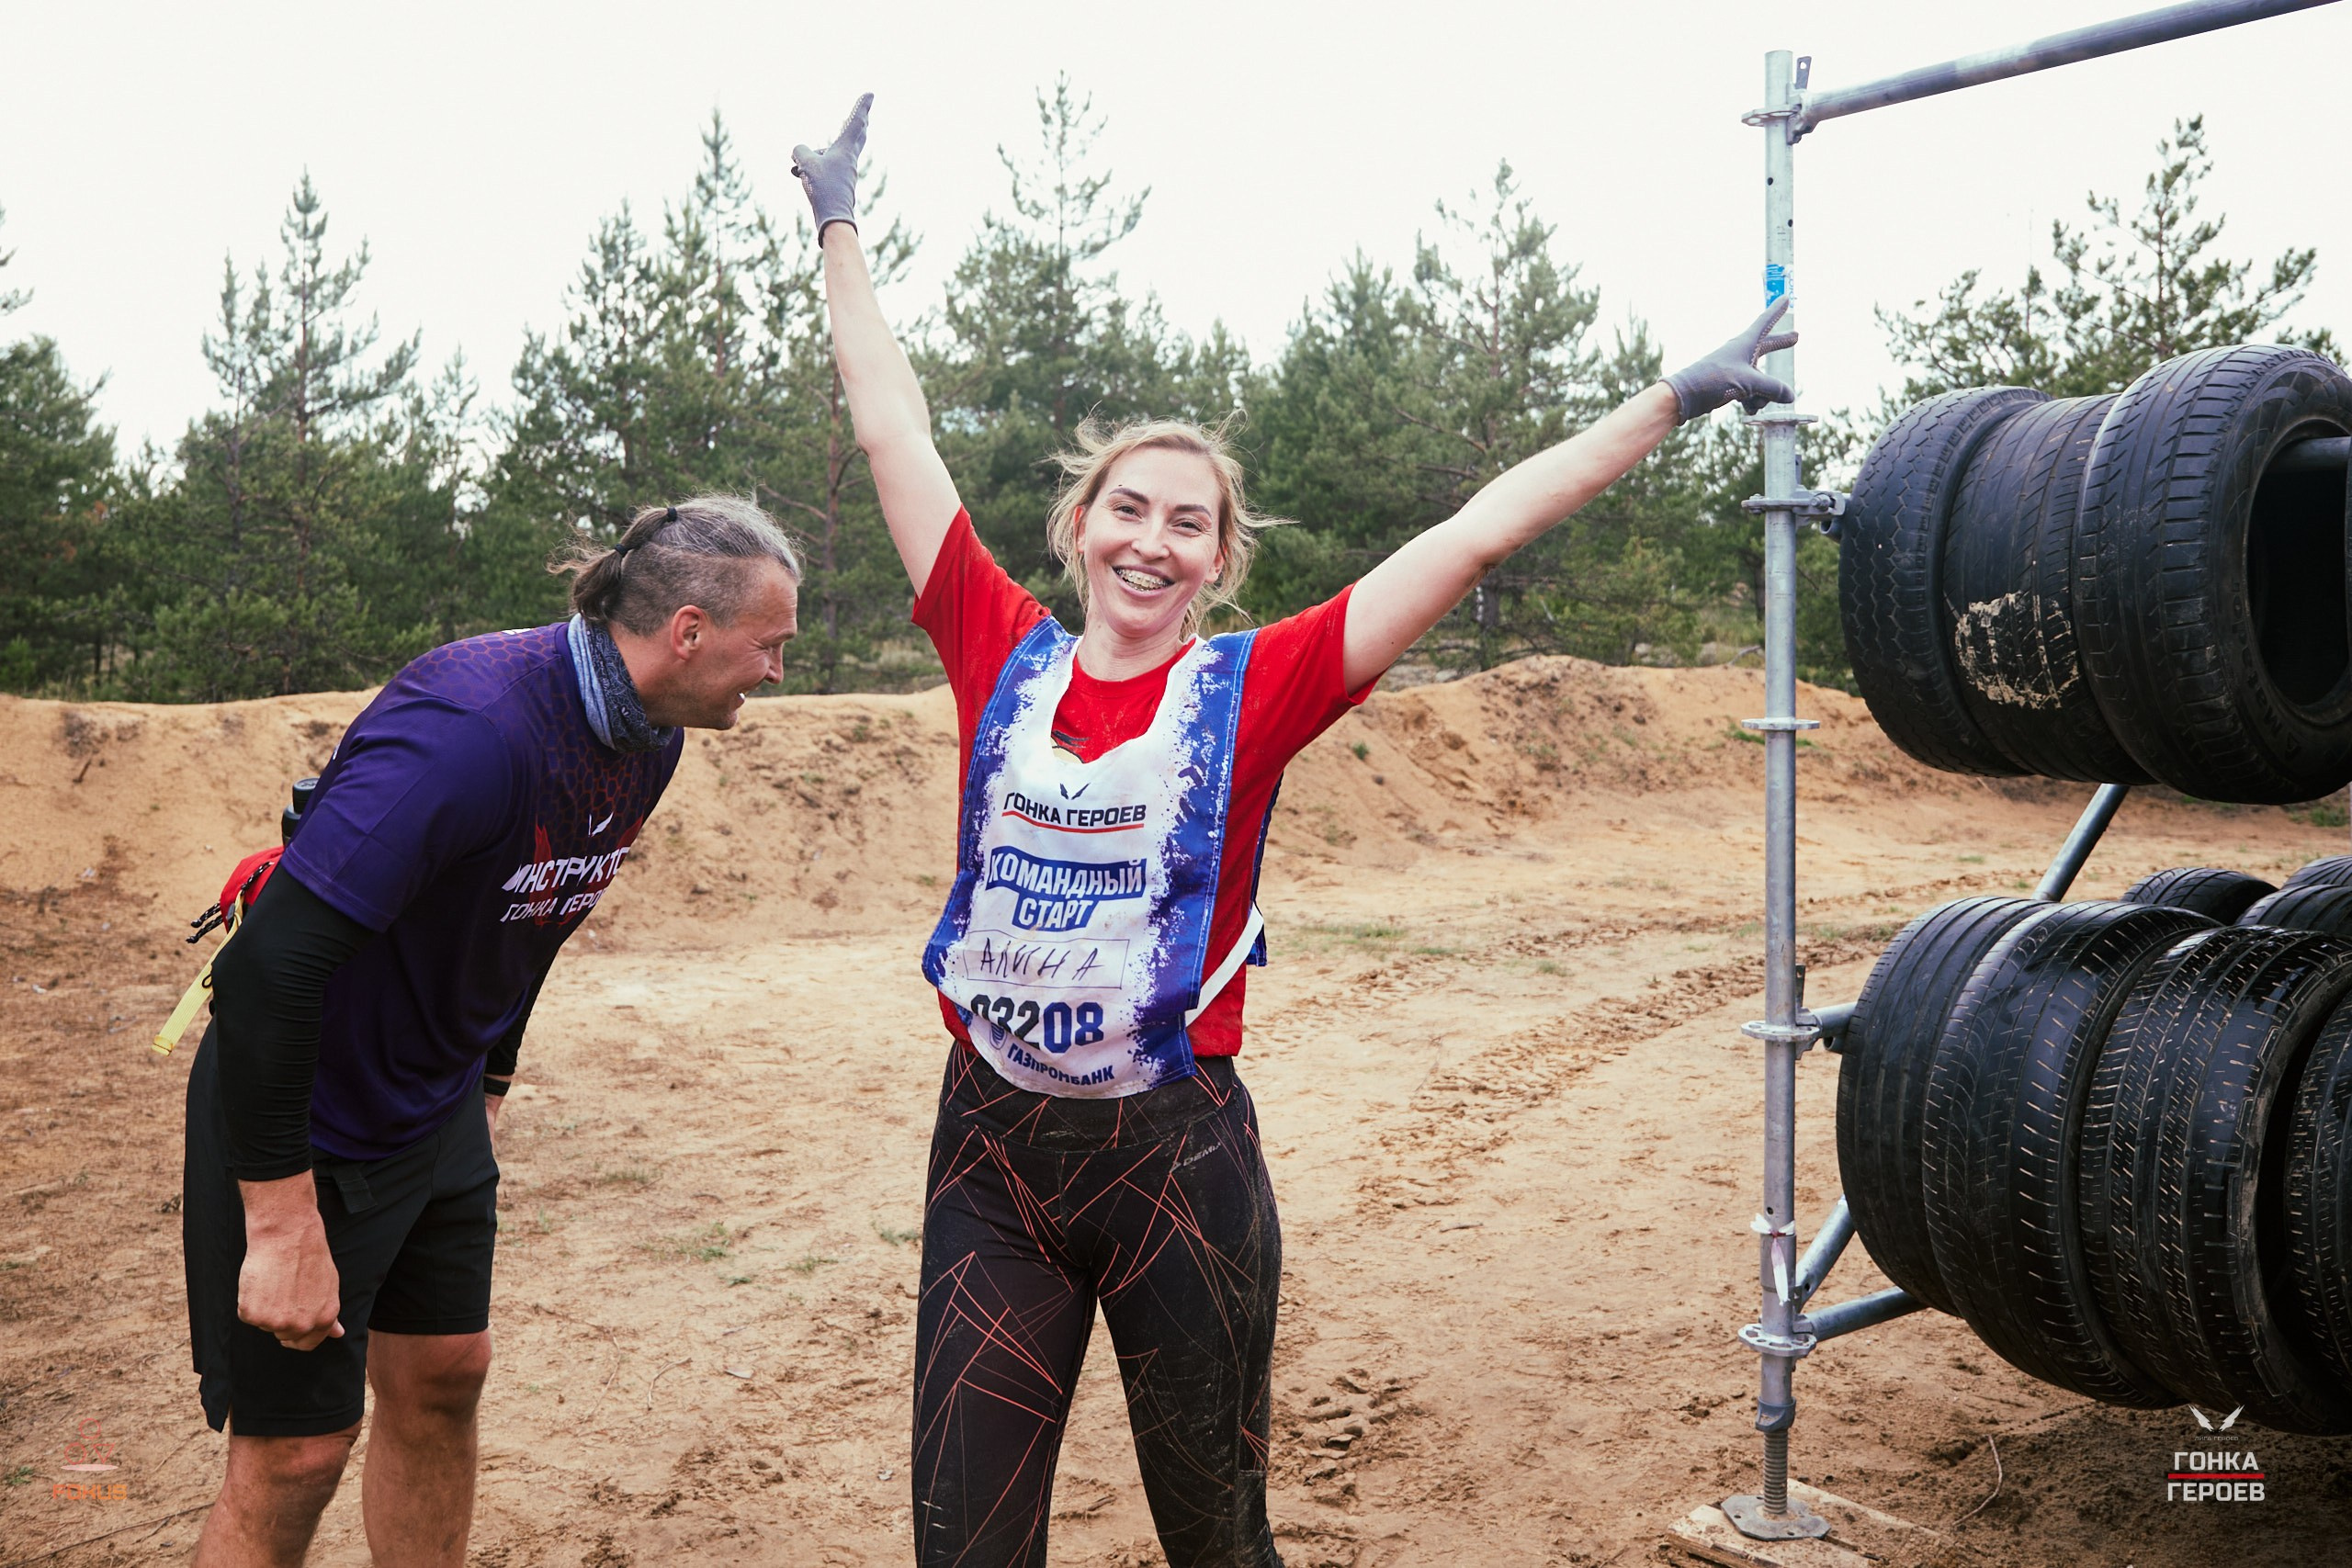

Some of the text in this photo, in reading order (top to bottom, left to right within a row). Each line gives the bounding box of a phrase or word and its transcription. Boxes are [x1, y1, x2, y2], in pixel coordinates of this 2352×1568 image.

[1003, 793, 1147, 827] ГОНКА ГЕРОЕВ
[501, 846, 631, 894] ИНСТРУКТО
[989, 852, 1143, 899] КОМАНДНЫЙ
[499, 887, 607, 923] ГОНКА ГЕРО
[1018, 897, 1094, 929] СТАРТ
[980, 937, 1105, 981] АЛИНА
[1007, 1043, 1115, 1086] ГАЗПРОМБАНК
